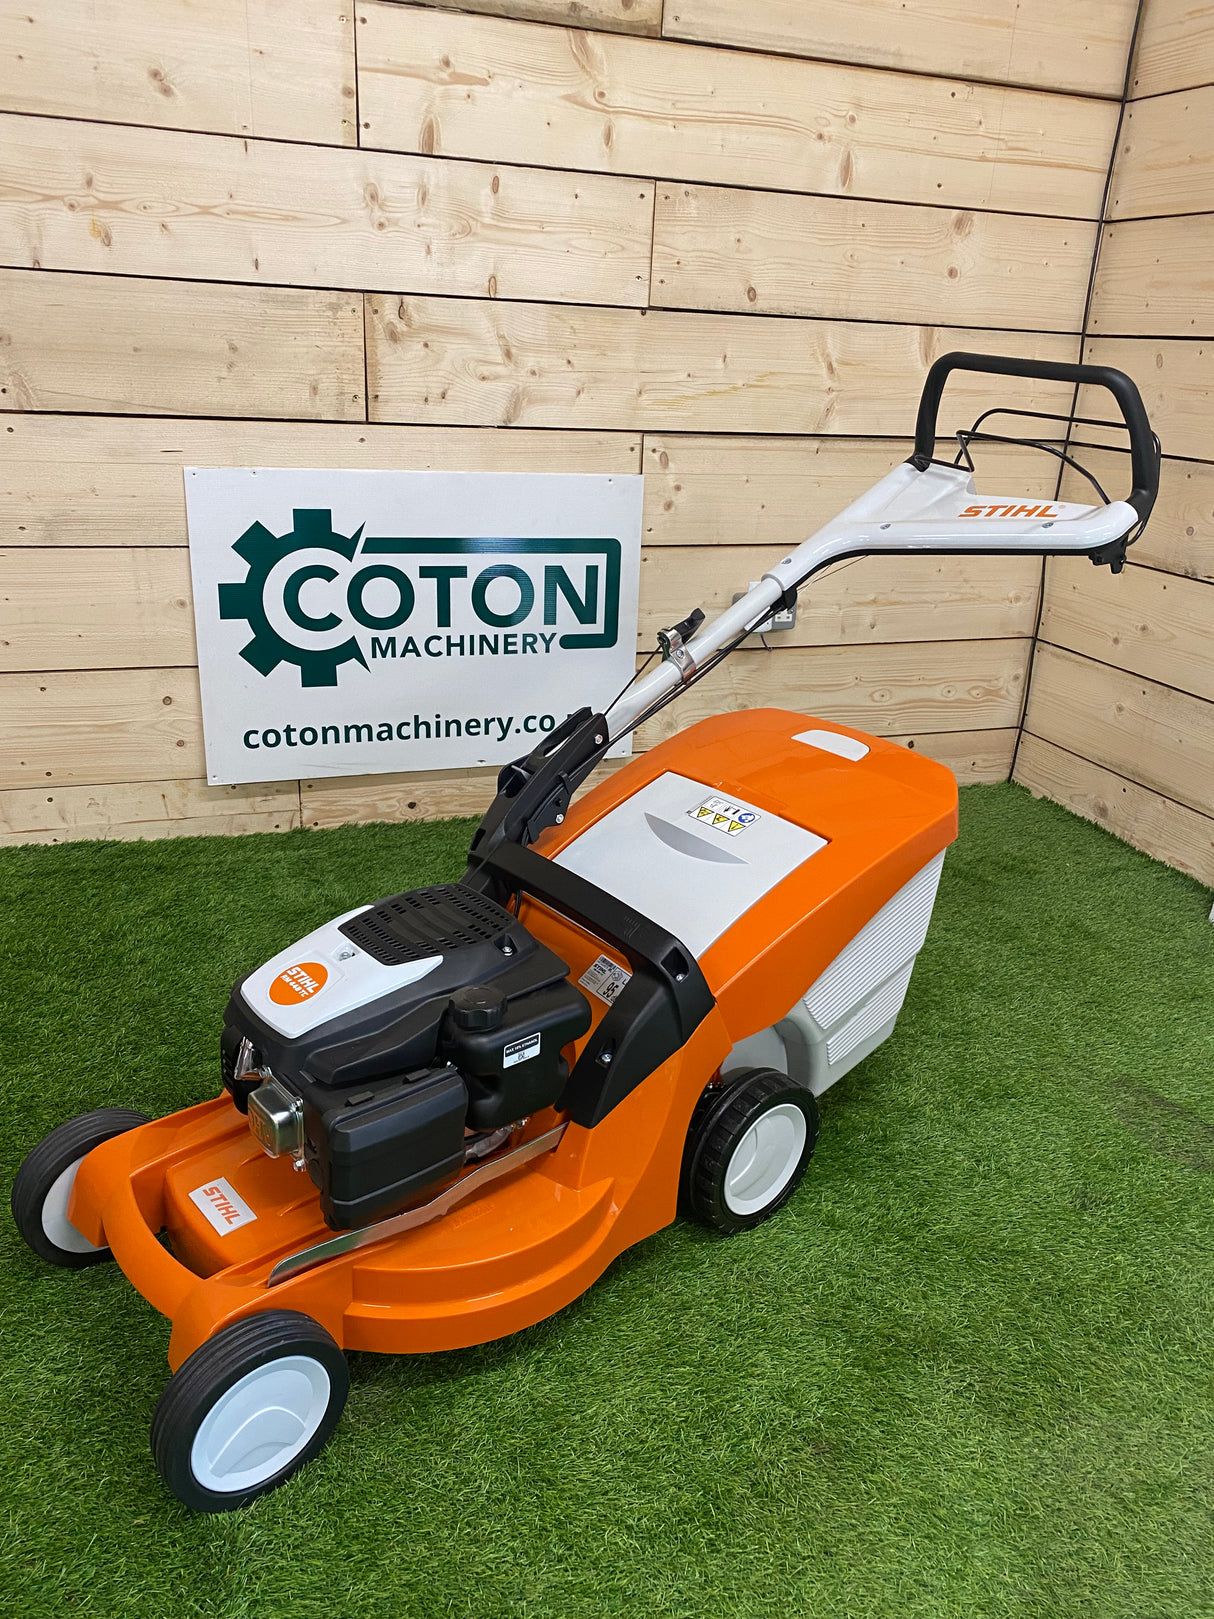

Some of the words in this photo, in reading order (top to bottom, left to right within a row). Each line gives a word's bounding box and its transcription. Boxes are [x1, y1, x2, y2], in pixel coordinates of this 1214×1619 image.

[958, 505, 1058, 518] STIHL
[283, 564, 599, 632] COTON
[371, 632, 557, 659] MACHINERY
[243, 706, 591, 750] cotonmachinery.co
[286, 966, 320, 994] STIHL
[602, 981, 620, 998] 95
[202, 1186, 241, 1225] STIHL
